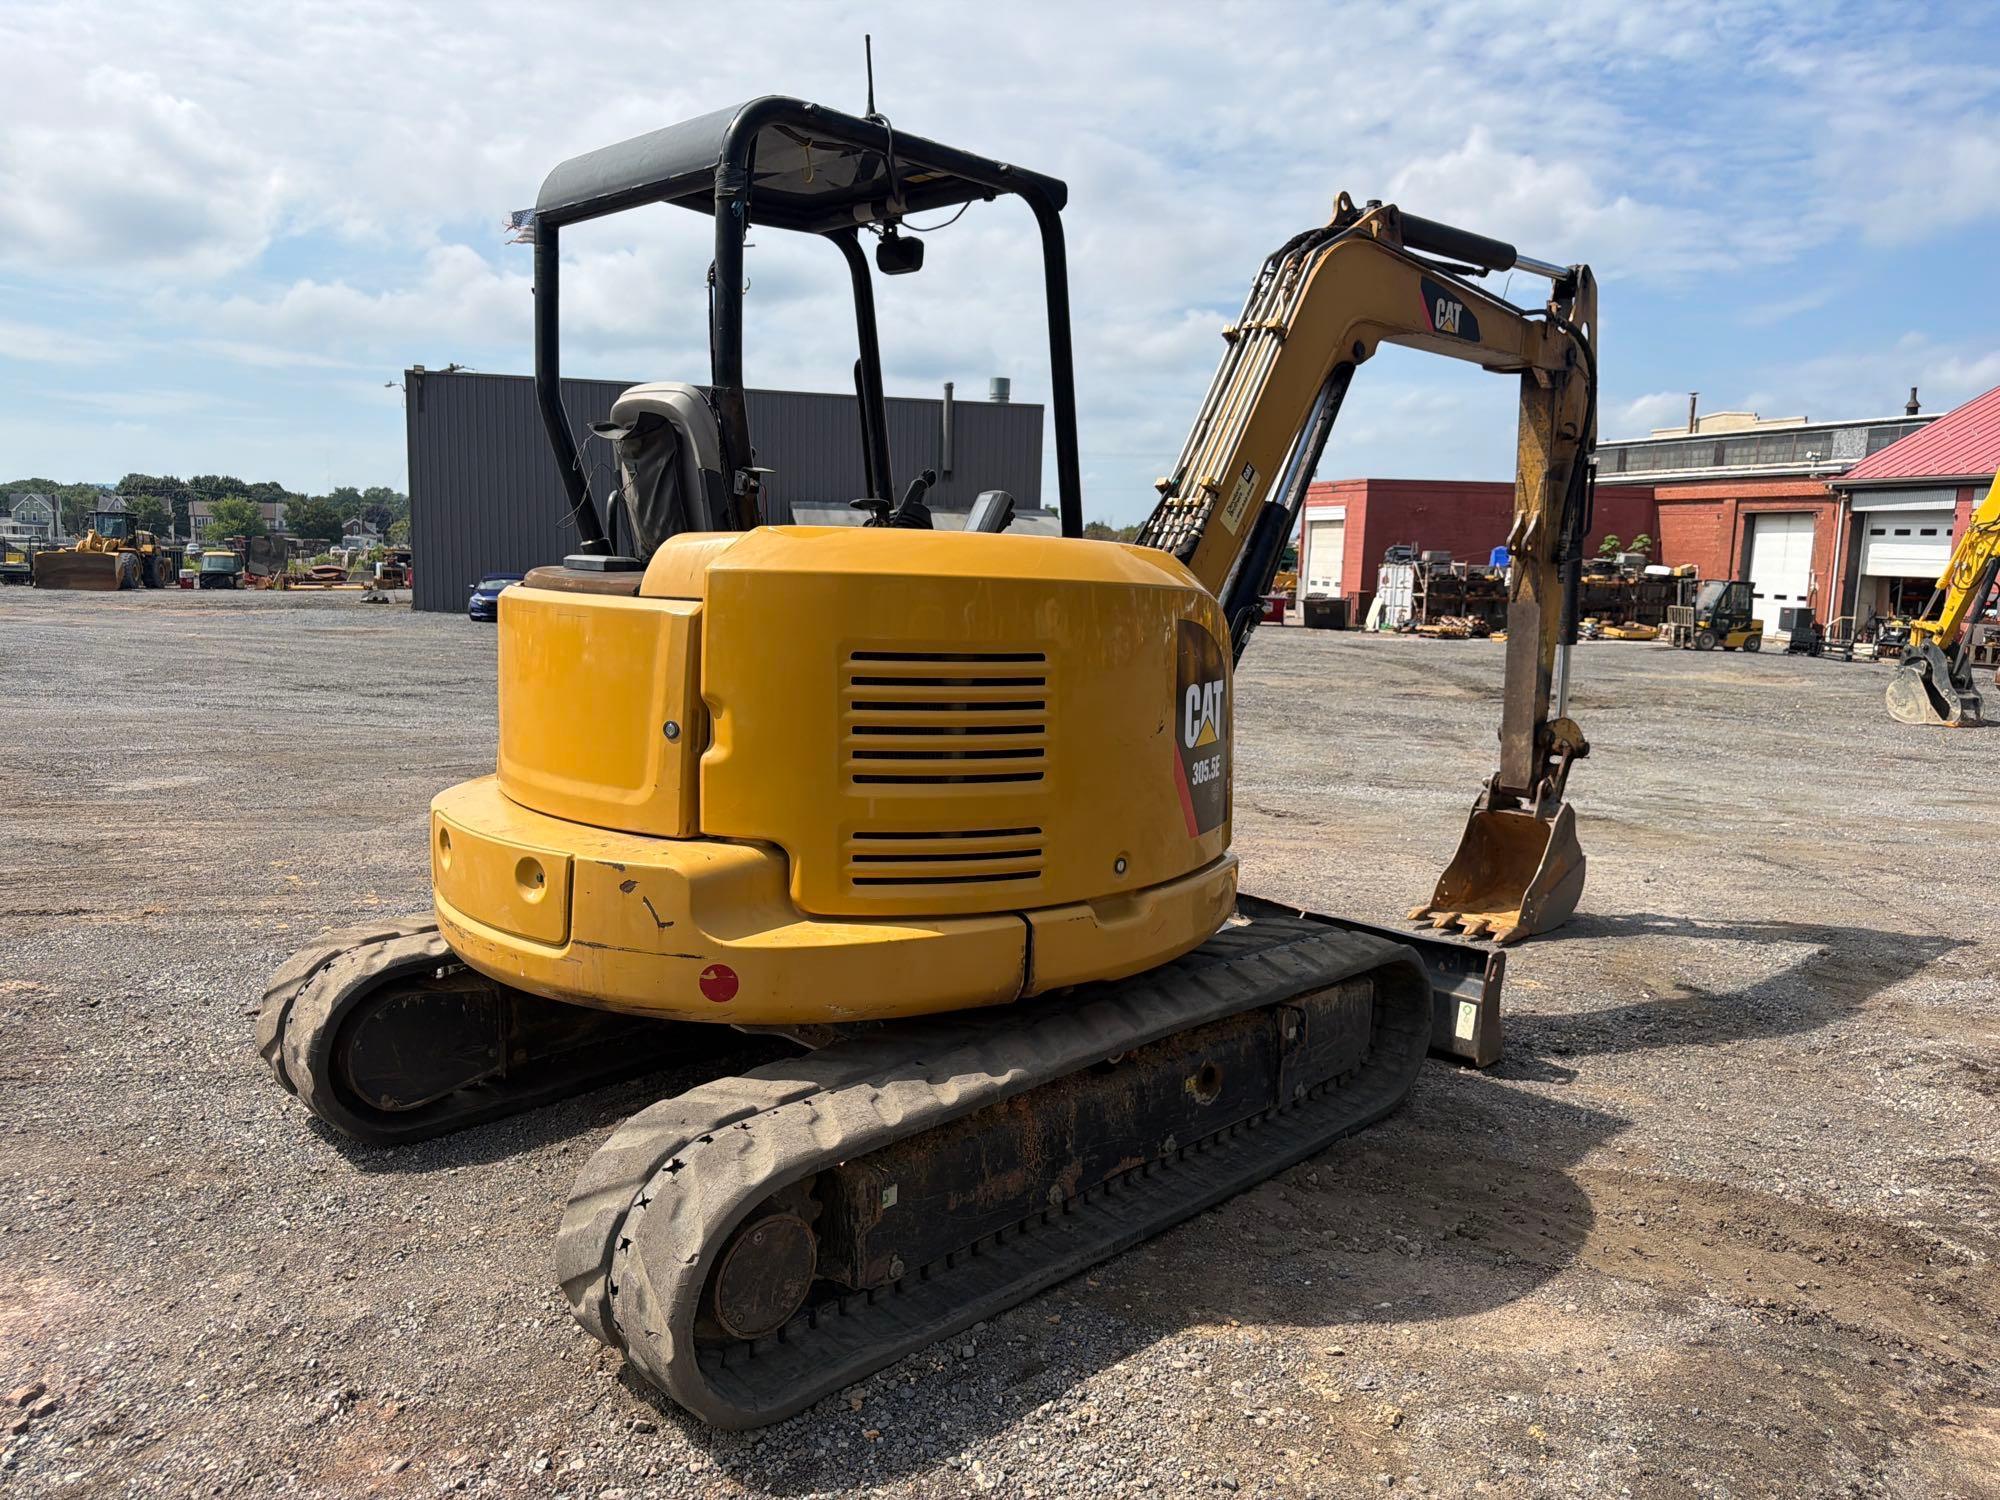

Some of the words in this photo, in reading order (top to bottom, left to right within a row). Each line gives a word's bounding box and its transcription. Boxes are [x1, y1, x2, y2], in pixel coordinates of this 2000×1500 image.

[1435, 298, 1463, 334] CAT
[1185, 680, 1223, 749] CAT
[1192, 755, 1221, 786] 305.5E
